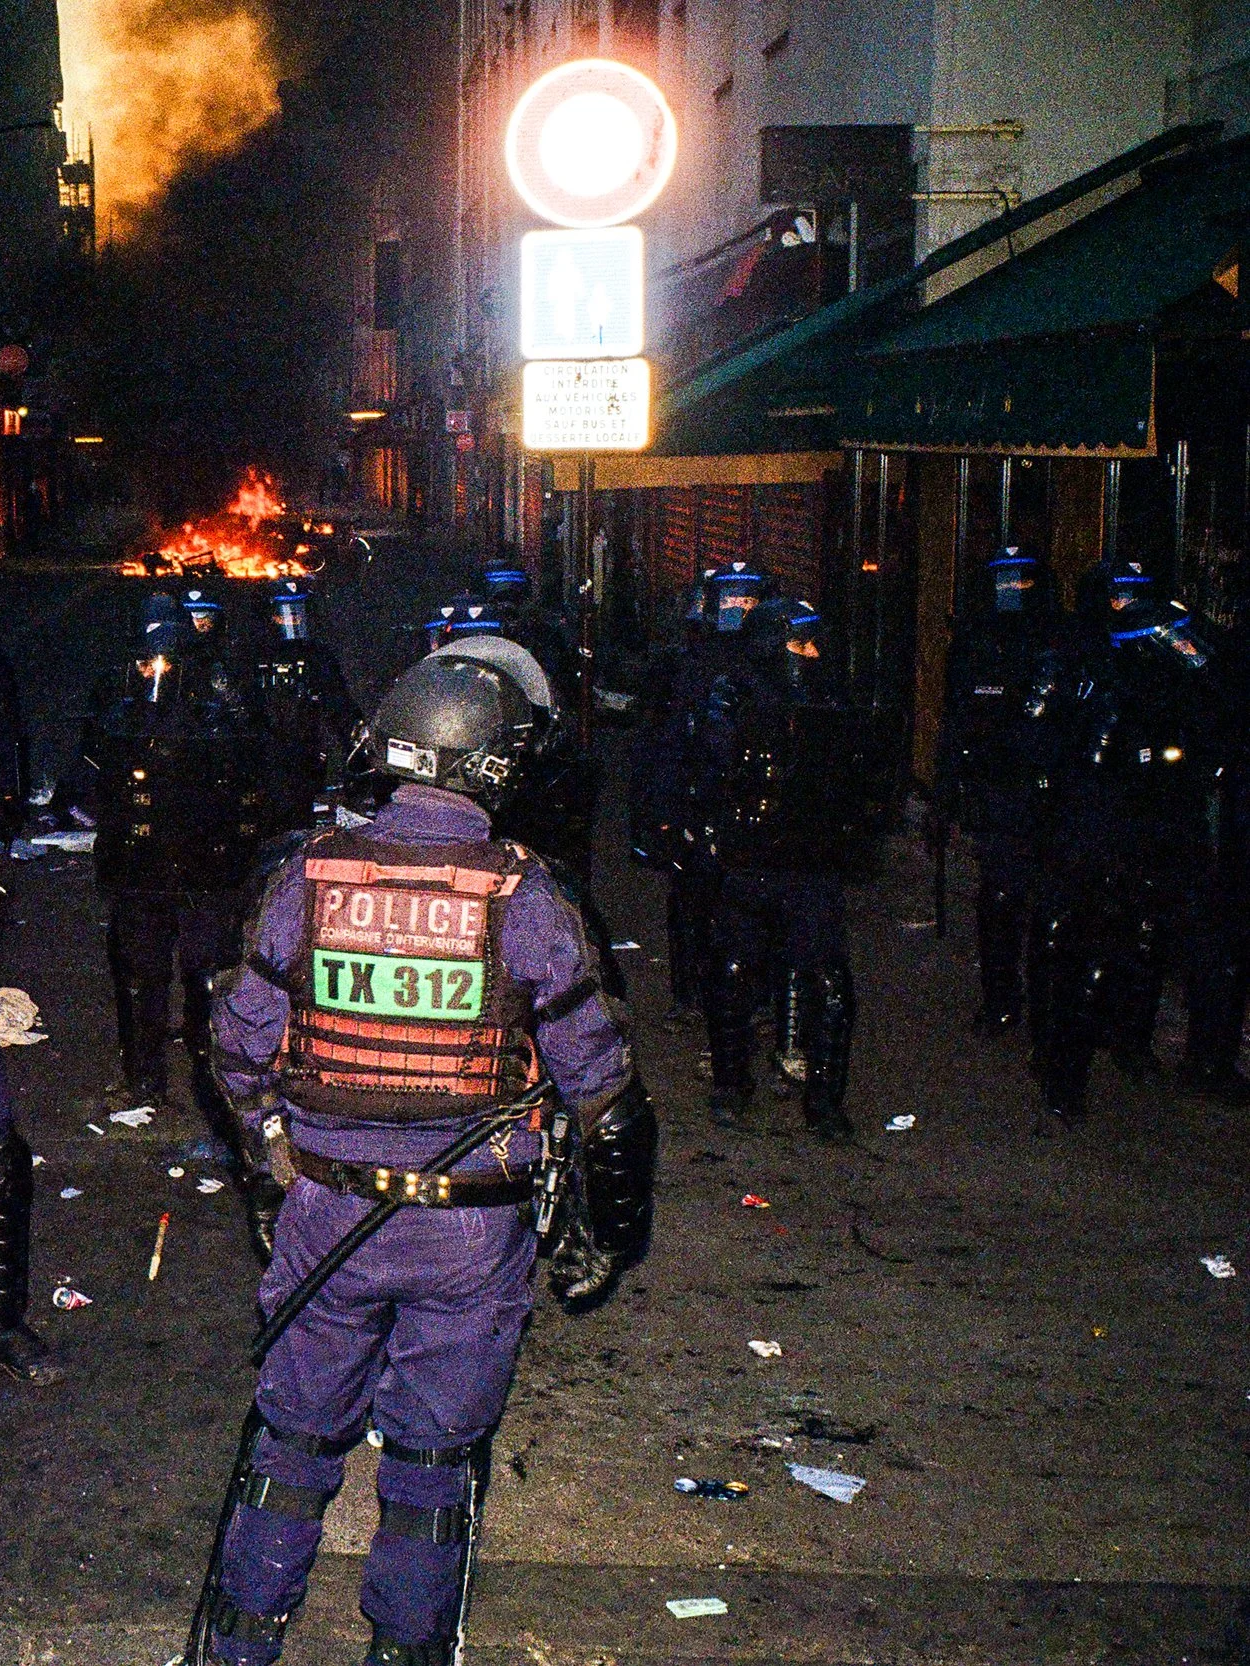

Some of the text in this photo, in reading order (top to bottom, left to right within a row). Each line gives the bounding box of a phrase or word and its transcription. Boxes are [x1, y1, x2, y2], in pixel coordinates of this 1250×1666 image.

[323, 889, 481, 936] POLICE
[322, 957, 474, 1011] TX 312
